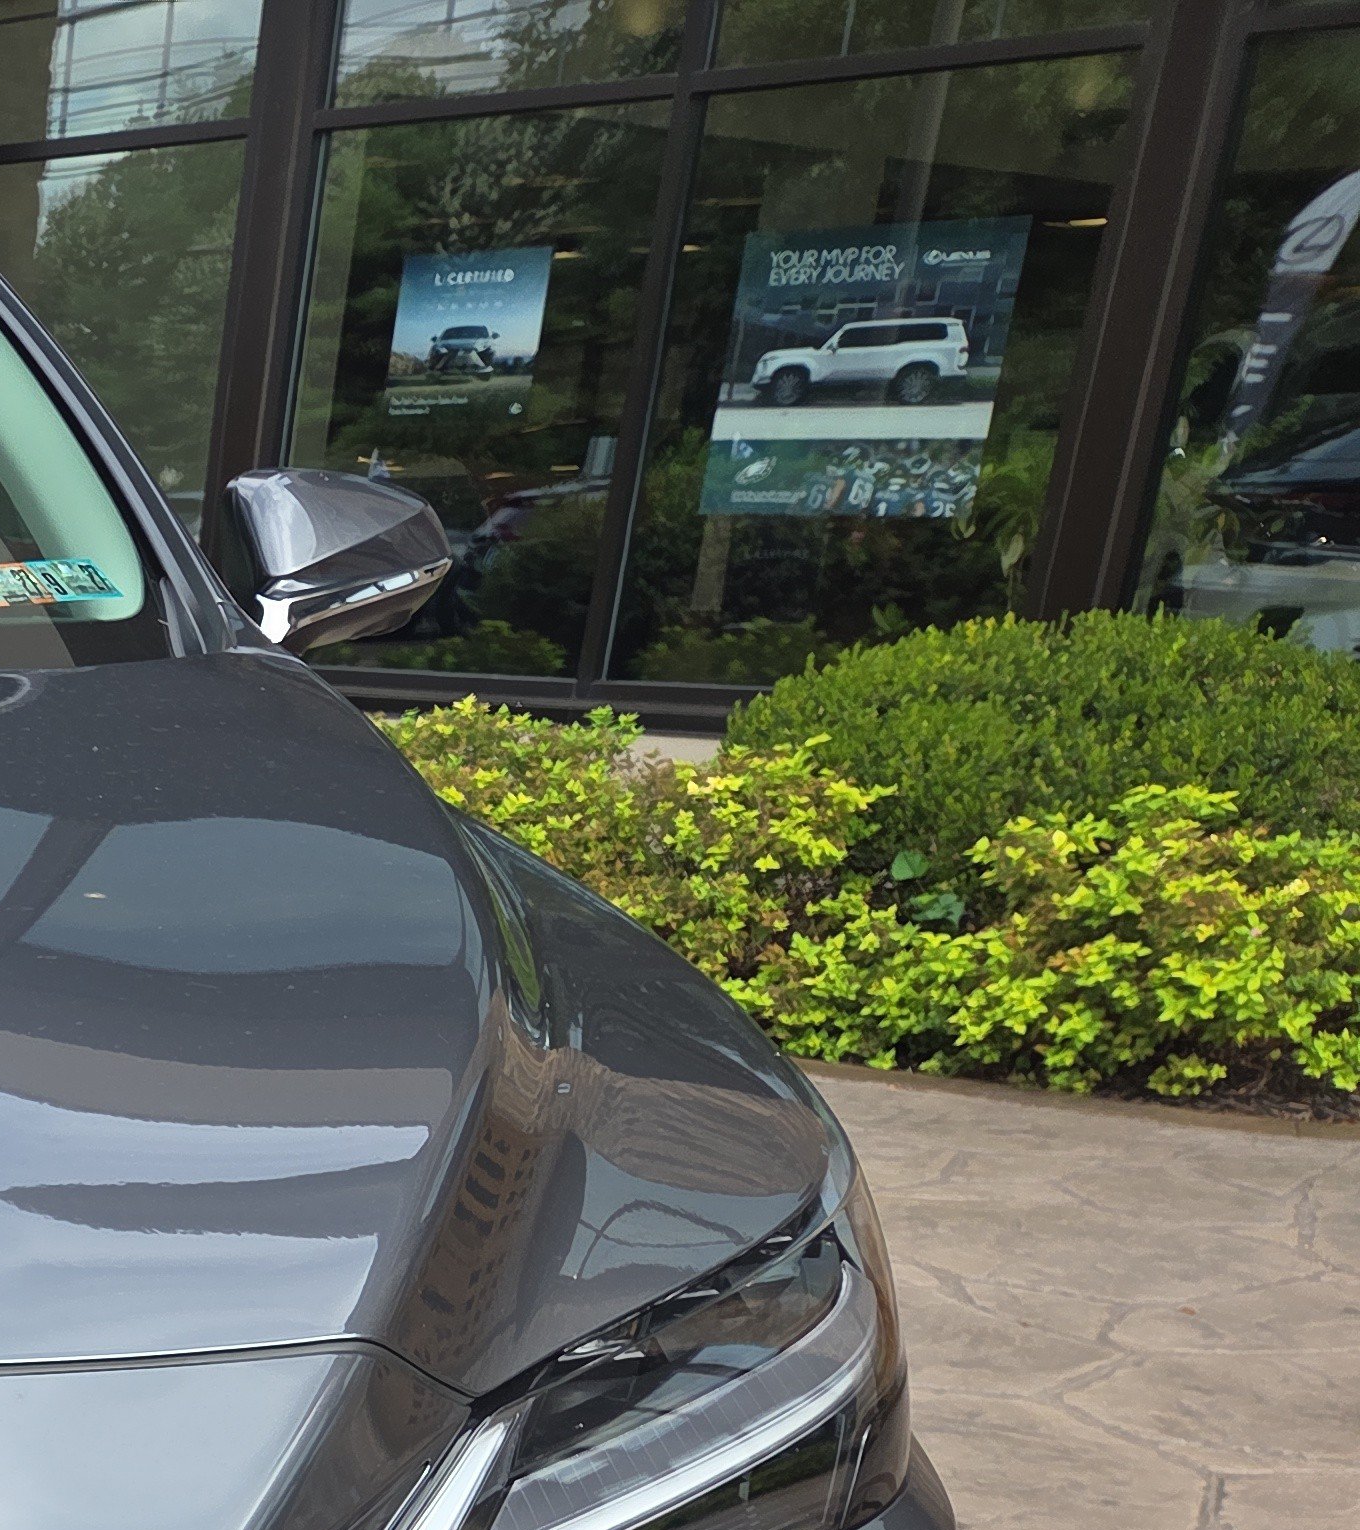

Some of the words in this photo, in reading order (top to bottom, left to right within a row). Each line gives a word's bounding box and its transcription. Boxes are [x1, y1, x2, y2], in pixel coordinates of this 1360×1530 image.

[770, 249, 819, 269] YOUR
[821, 246, 858, 267] MVP
[858, 244, 897, 265] FOR
[768, 266, 821, 287] EVERY
[821, 261, 906, 285] JOURNEY
